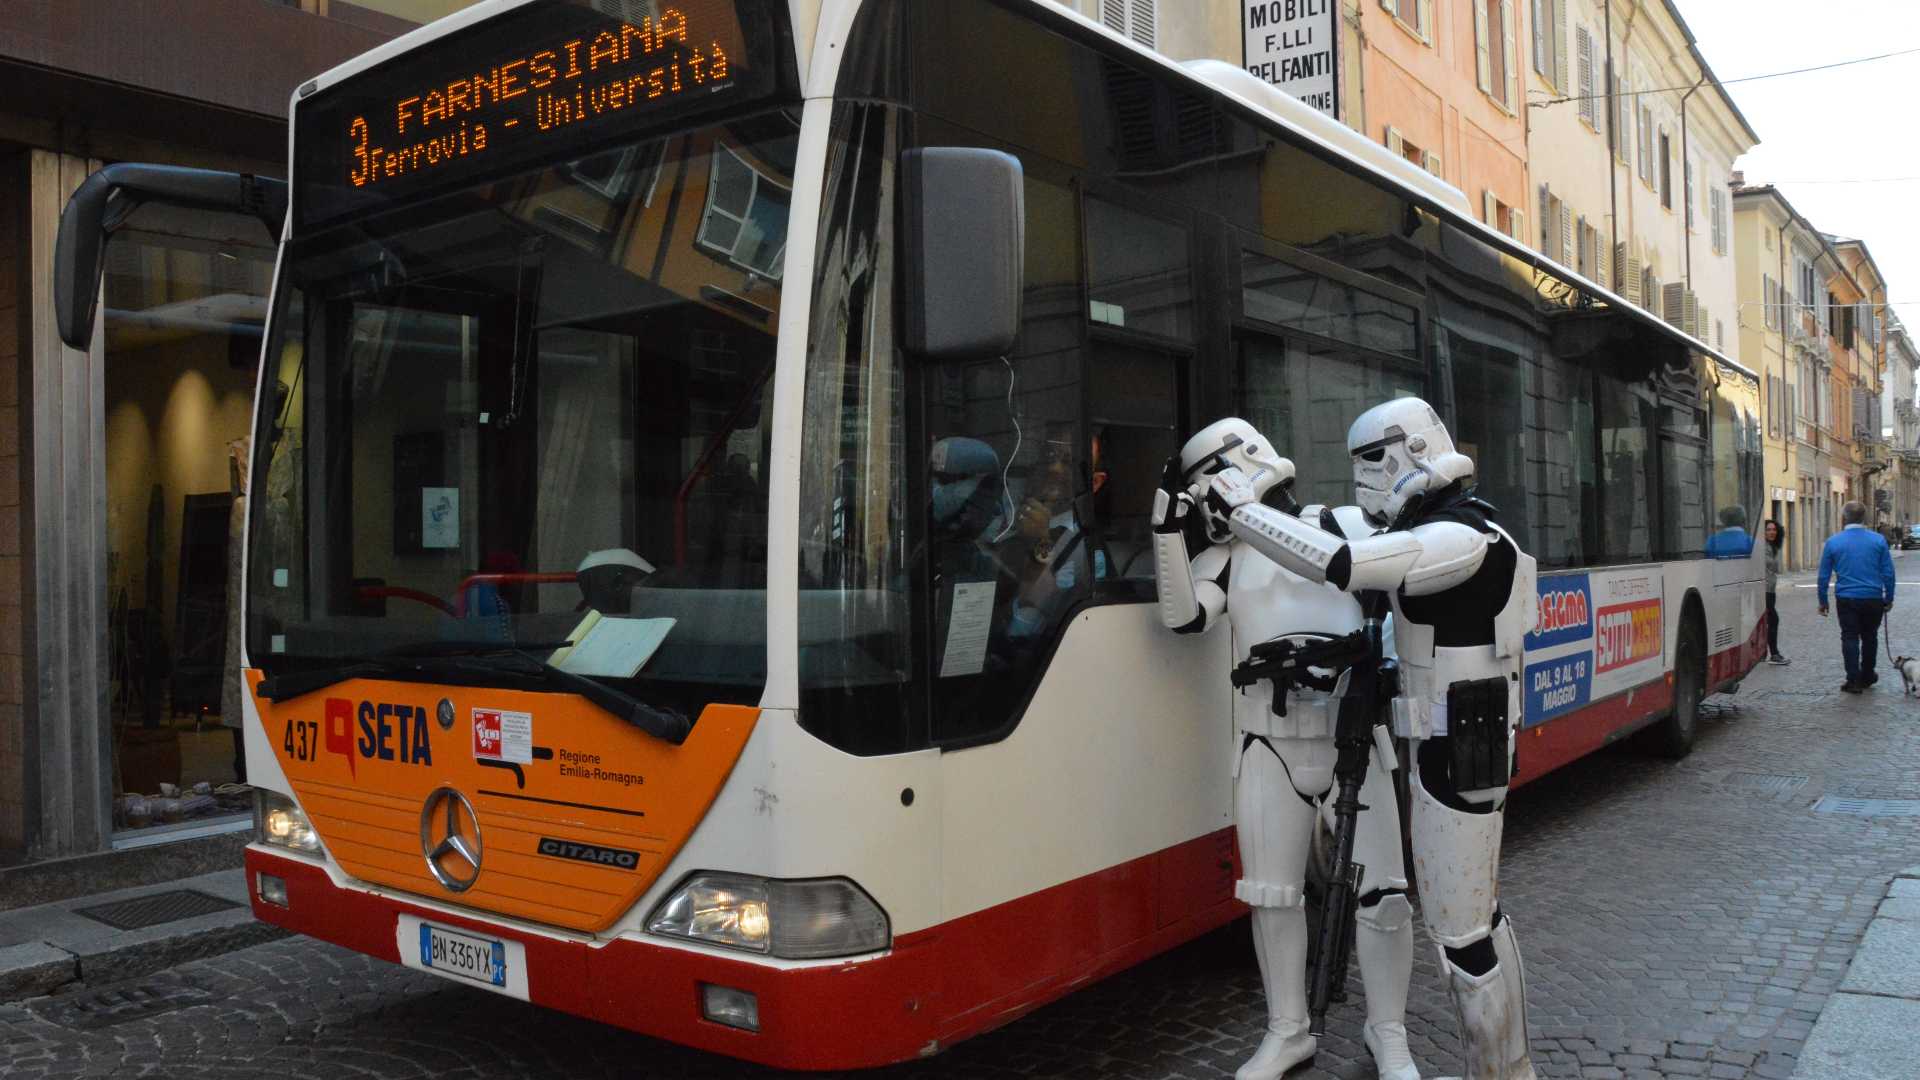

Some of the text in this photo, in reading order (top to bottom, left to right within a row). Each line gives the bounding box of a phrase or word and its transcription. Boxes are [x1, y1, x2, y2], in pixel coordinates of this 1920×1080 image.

[1250, 0, 1326, 29] MOBILI
[1265, 27, 1312, 53] F.LLI
[350, 8, 688, 187] 3 FARNESIANA
[371, 120, 488, 182] Ferrovia
[537, 39, 729, 131] Università
[1534, 660, 1586, 692] DAL 9 AL 18
[1543, 684, 1576, 712] MAGGIO
[284, 719, 318, 762] 437
[358, 700, 432, 767] SETA
[560, 748, 600, 765] Regione
[560, 764, 644, 786] Emilia-Romagna
[542, 840, 635, 867] CITARO
